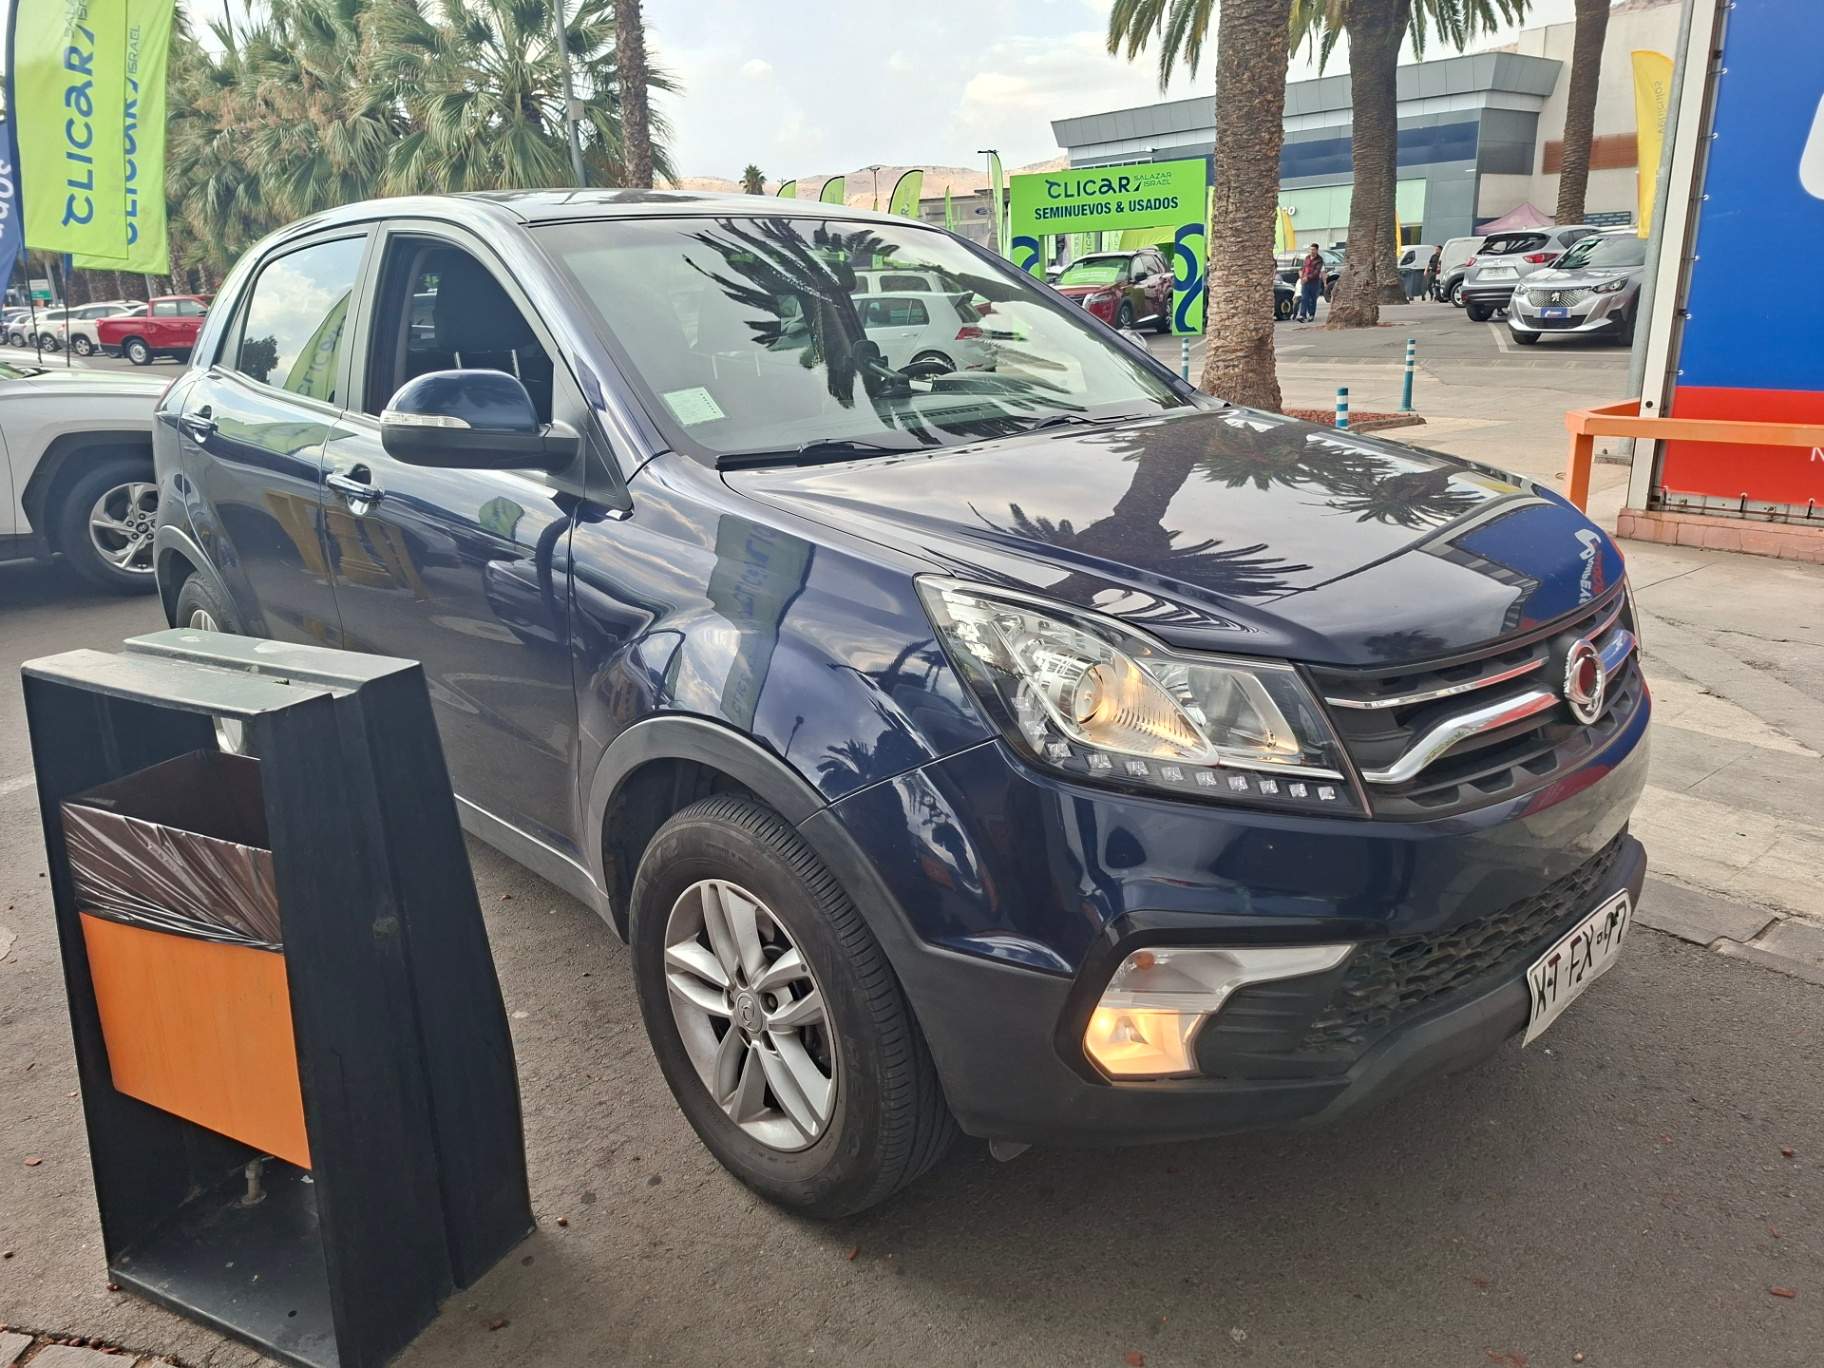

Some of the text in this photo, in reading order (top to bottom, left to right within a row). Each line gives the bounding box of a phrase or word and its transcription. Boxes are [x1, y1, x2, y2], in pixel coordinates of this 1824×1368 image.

[127, 24, 141, 75] ISRAEL
[1134, 172, 1172, 181] SALAZAR
[1143, 179, 1172, 187] ISRAEL
[1034, 196, 1179, 220] SEMINUEVOS & USADOS
